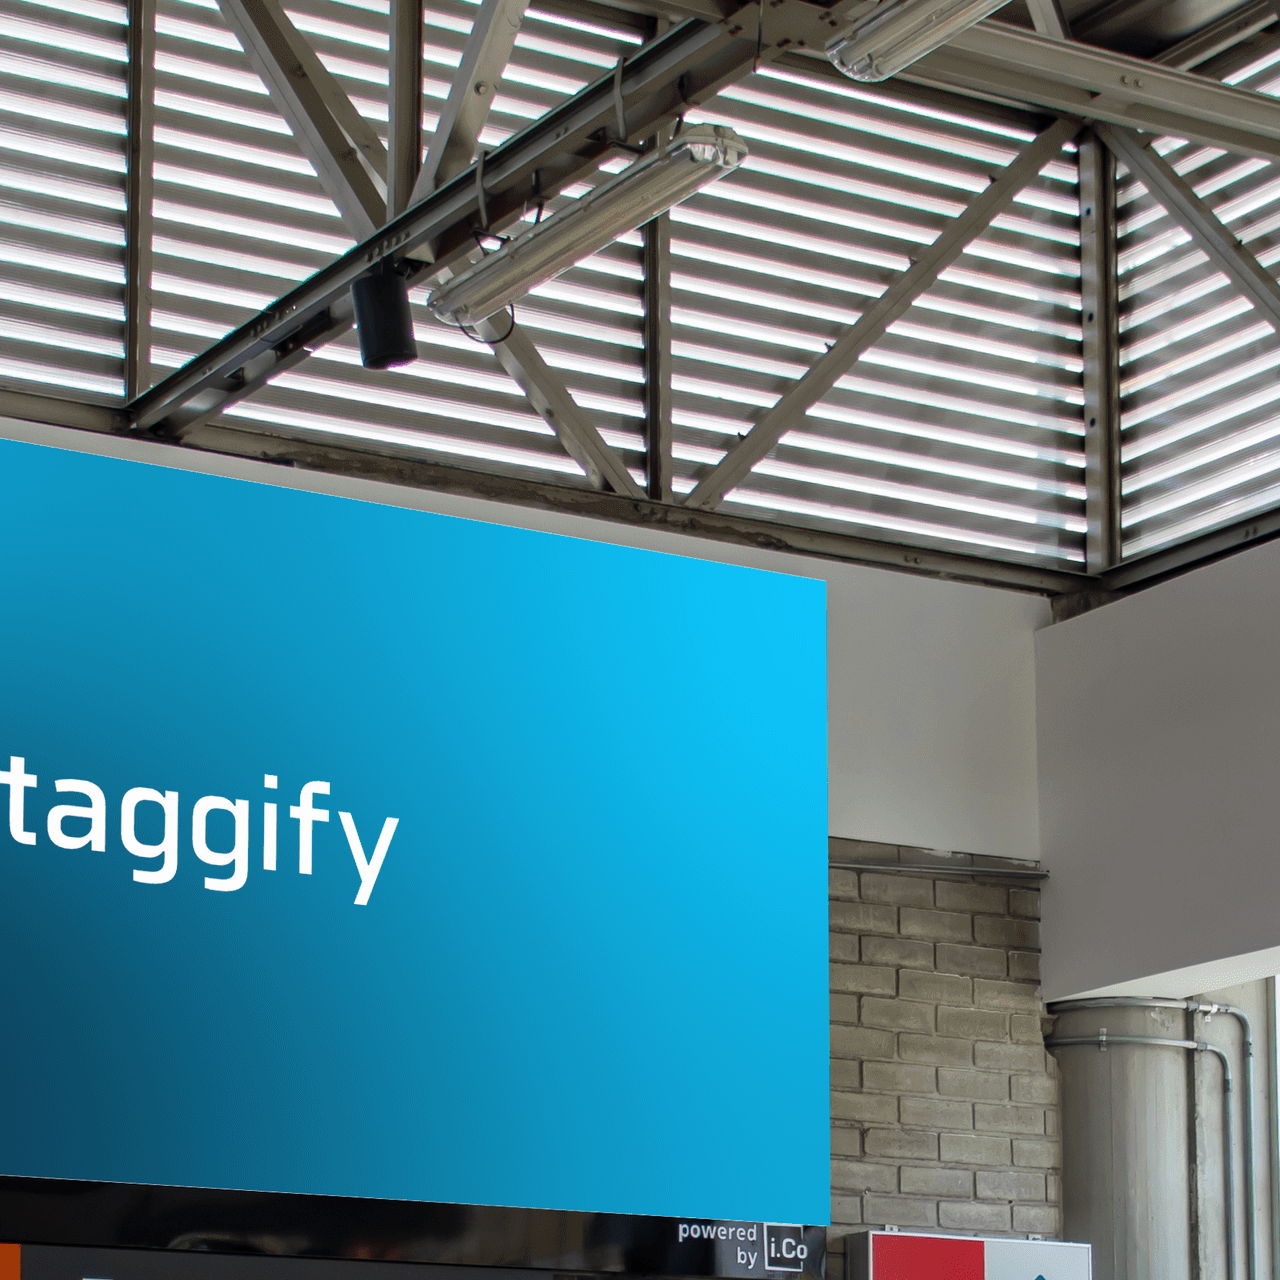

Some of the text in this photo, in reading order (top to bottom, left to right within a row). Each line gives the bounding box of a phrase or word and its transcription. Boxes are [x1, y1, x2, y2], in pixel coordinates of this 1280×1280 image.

[678, 1223, 757, 1242] powered
[737, 1246, 758, 1269] by
[770, 1237, 808, 1259] i.Co
